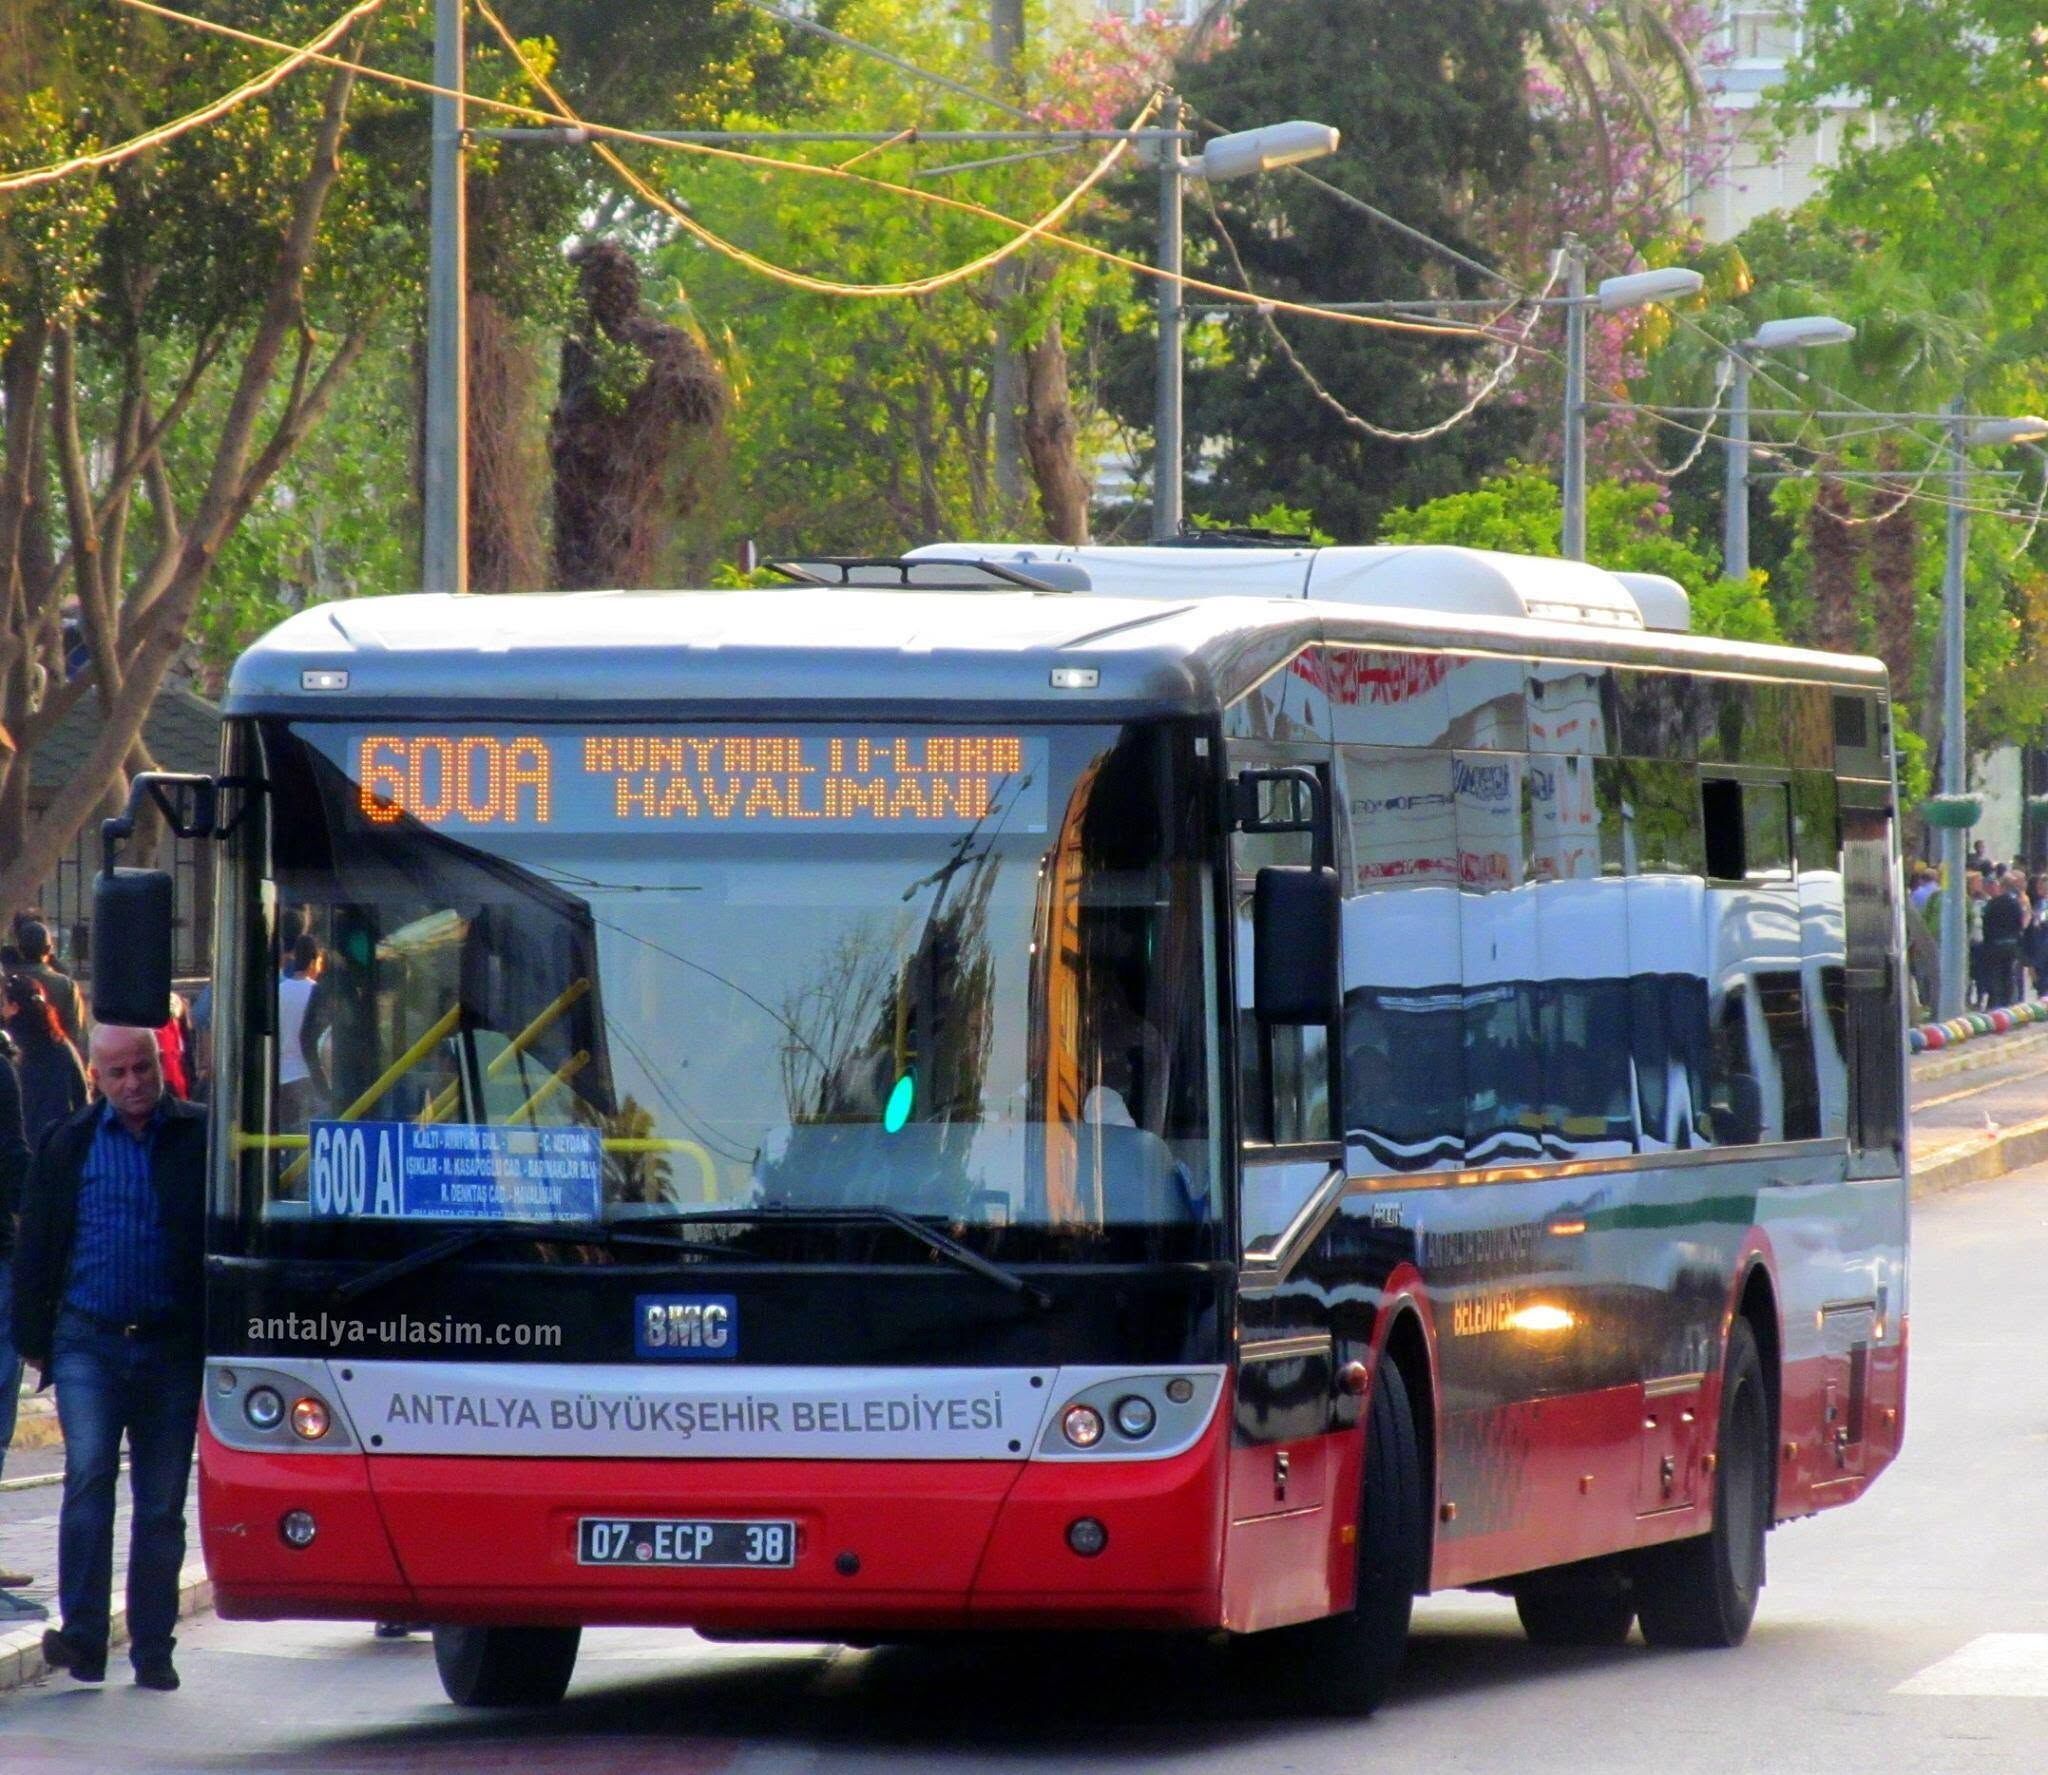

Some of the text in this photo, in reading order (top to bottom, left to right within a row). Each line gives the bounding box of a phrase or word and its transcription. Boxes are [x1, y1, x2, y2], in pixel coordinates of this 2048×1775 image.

[360, 736, 549, 823] 600A
[315, 1127, 395, 1215] 600 A
[645, 1303, 729, 1348] BMC
[387, 1390, 1003, 1439] ANTALYA BÜYÜKŞEHİR BELEDİYESİ
[591, 1523, 784, 1562] 07 ECP 38
